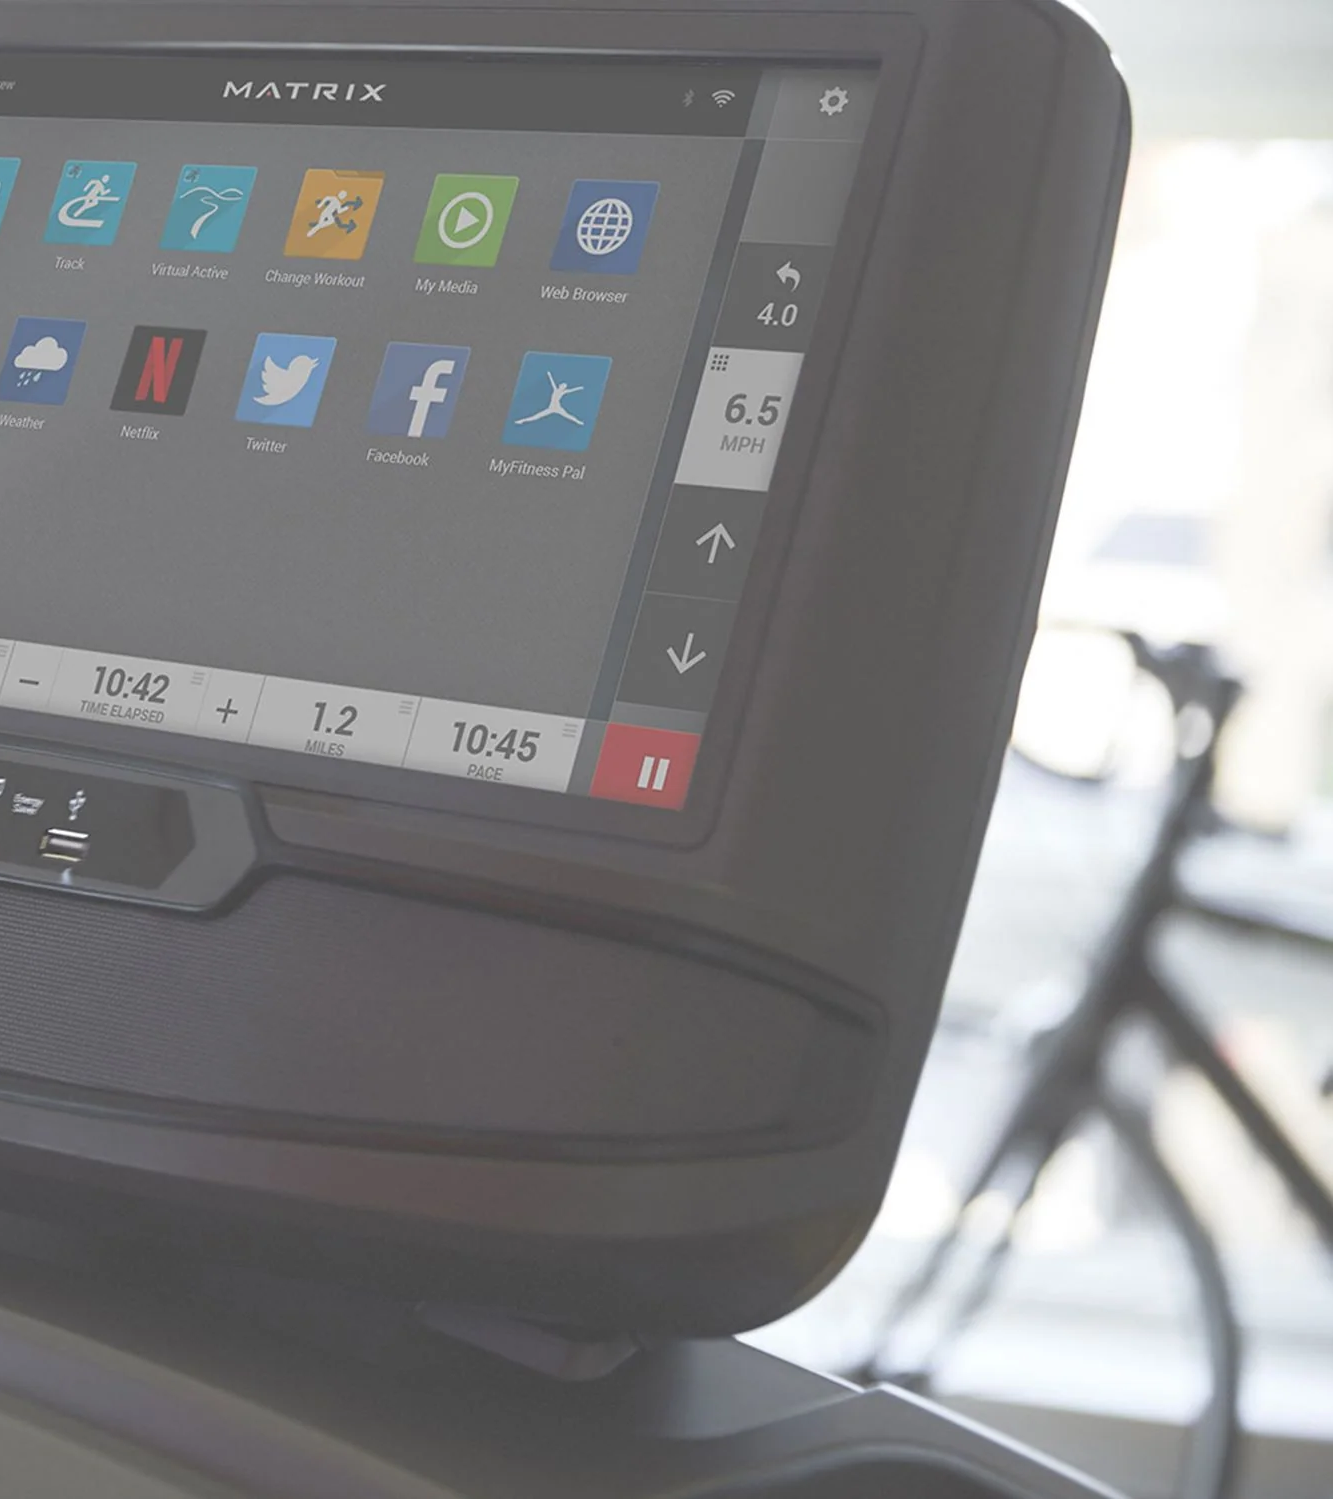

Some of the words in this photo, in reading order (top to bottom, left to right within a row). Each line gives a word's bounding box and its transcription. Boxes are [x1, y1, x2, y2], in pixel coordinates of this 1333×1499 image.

[222, 80, 387, 102] MATRIX
[54, 256, 85, 271] Track
[151, 262, 190, 278] Virtual
[192, 265, 229, 280] Active
[264, 269, 311, 287] Change
[312, 273, 365, 288] Workout
[415, 277, 438, 296] My
[440, 280, 479, 295] Media
[540, 285, 571, 301] Web
[572, 286, 629, 303] Browser
[756, 302, 799, 327] 4.0
[723, 393, 782, 426] 6.5
[0, 413, 45, 430] Weather
[120, 425, 160, 441] Netflix
[245, 437, 287, 454] Twitter
[720, 435, 765, 455] MPH
[366, 448, 430, 467] Facebook
[489, 458, 560, 479] MyFitness
[562, 464, 586, 481] Pal
[94, 666, 170, 704] 10:42
[79, 701, 109, 718] TIME
[110, 704, 165, 724] ELAPSED
[312, 701, 359, 737] 1.2
[304, 739, 345, 757] MILES
[452, 721, 541, 764] 10:45
[467, 764, 503, 782] PACE
